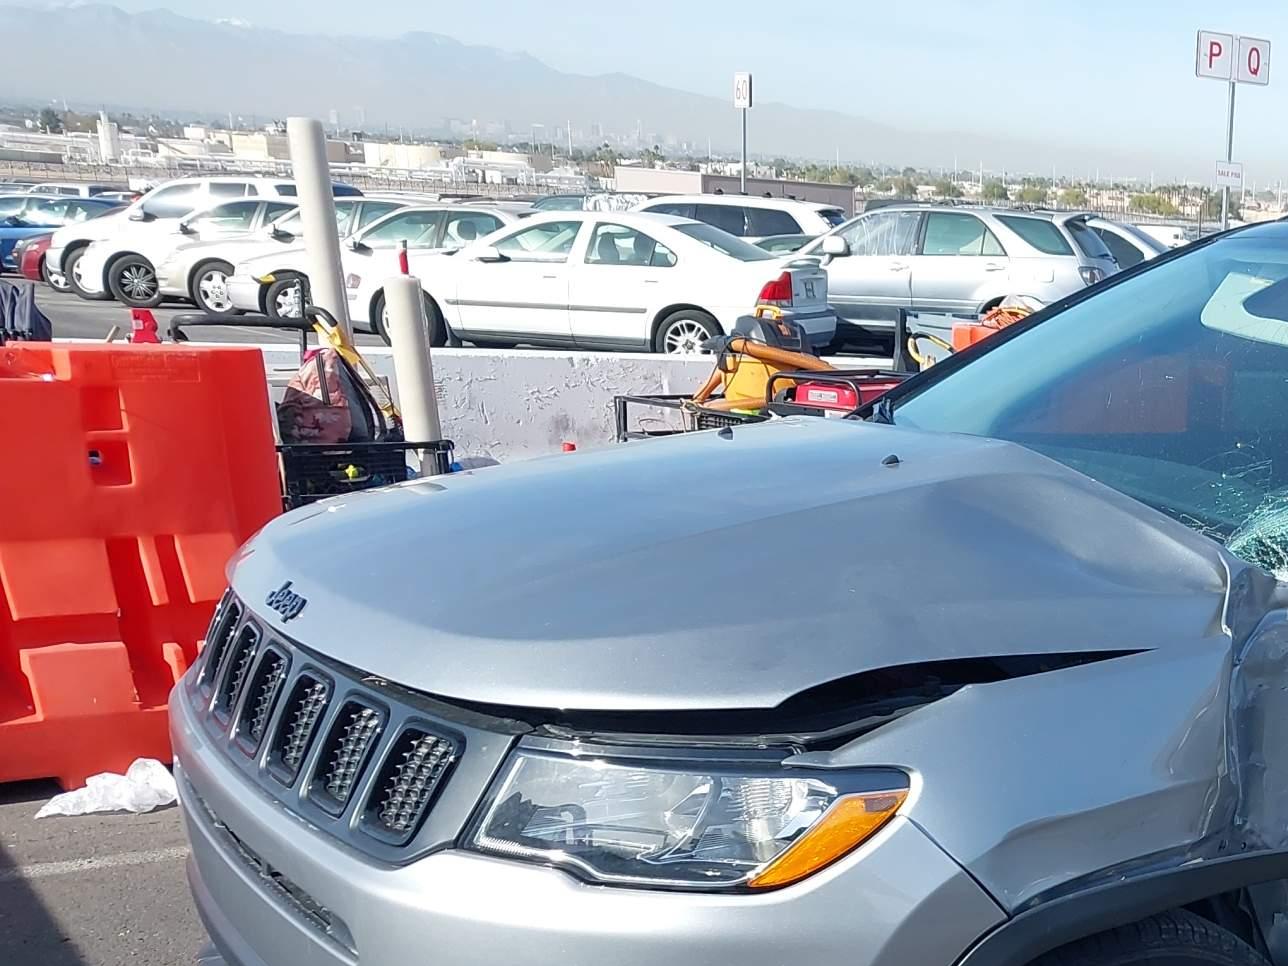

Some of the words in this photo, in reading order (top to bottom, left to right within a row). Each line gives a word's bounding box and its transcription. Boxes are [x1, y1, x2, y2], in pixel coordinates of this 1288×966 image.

[1209, 40, 1222, 69] P
[1247, 47, 1261, 76] Q
[735, 79, 748, 100] 60
[265, 580, 307, 624] Jeep
